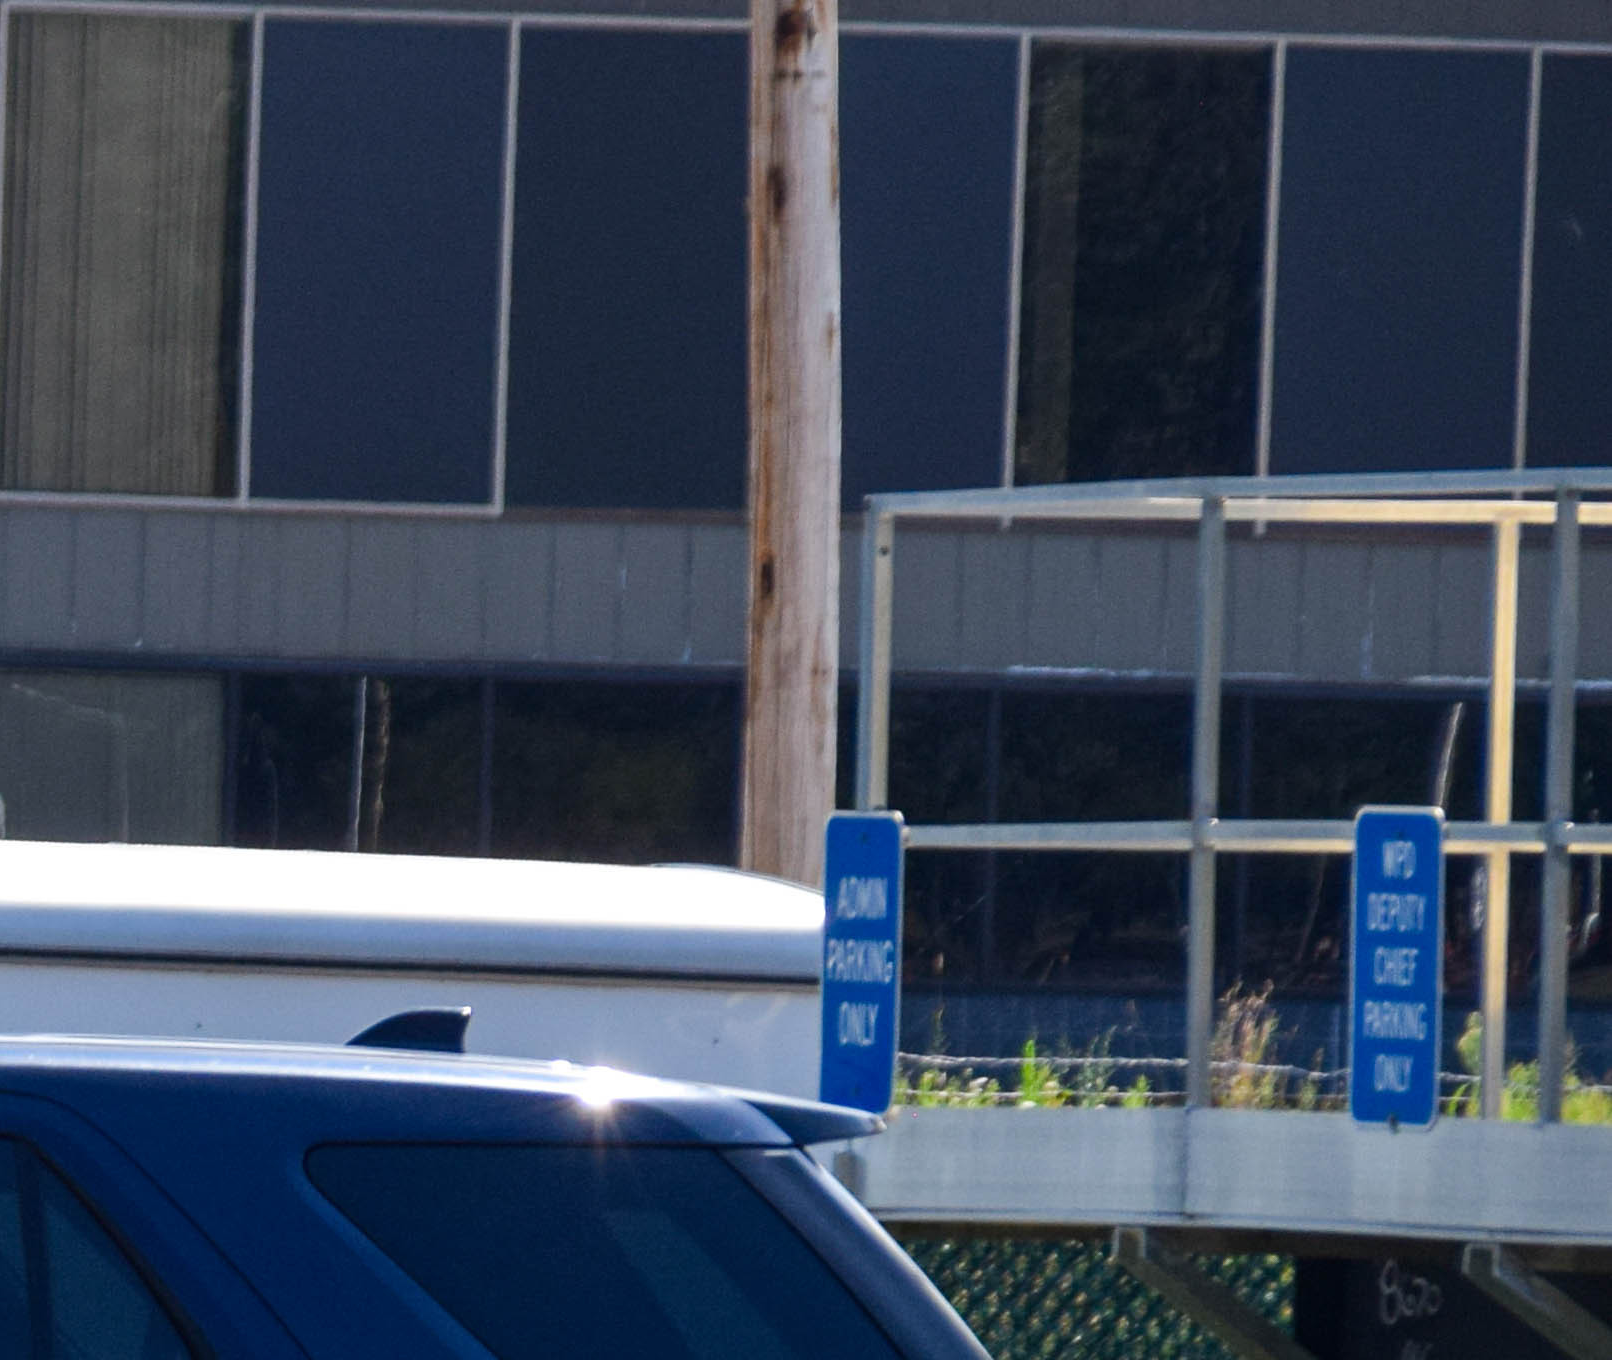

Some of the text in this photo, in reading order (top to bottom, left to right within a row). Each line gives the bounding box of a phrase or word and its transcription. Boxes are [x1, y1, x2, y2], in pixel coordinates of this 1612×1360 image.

[836, 876, 888, 920] ADMIN
[1367, 893, 1426, 932] DEPUTY
[827, 938, 894, 984] PARKING
[1374, 947, 1418, 987] CHIEF
[838, 1001, 879, 1047] ONLY
[1363, 1001, 1427, 1041] PARKING
[1373, 1054, 1414, 1092] ONLY
